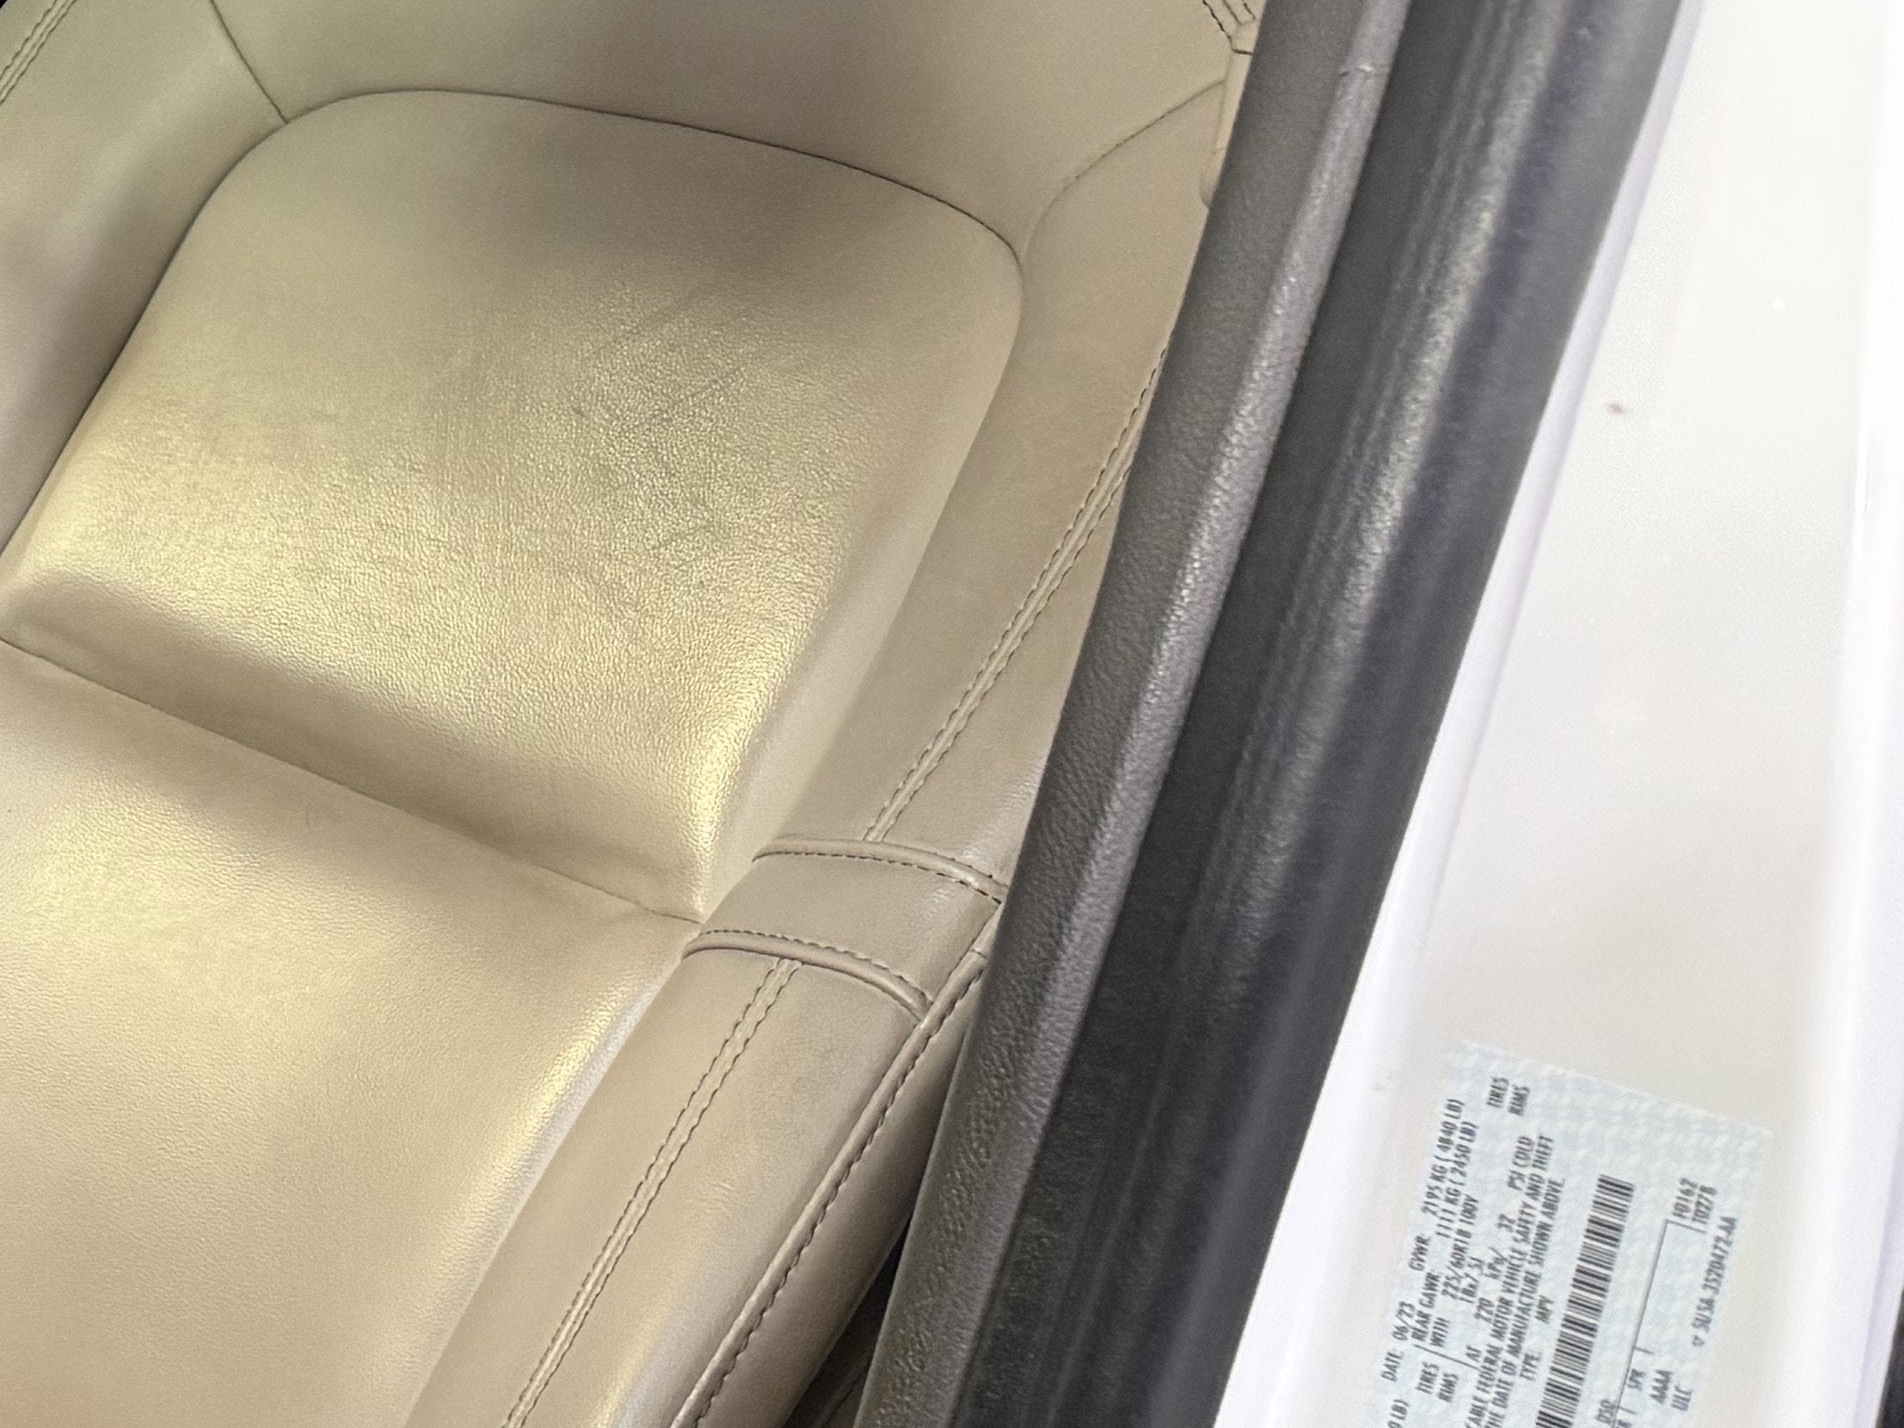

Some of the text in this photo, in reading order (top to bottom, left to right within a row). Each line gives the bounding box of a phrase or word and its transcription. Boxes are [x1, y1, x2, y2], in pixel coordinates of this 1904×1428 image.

[1531, 1134, 1554, 1171] THEFT
[1523, 1172, 1546, 1201] AND
[1511, 1200, 1539, 1246] SAFETY
[1526, 1220, 1553, 1267] SHOWN
[1410, 1309, 1431, 1341] REAR
[1442, 1186, 1462, 1206] KG
[1462, 1343, 1482, 1362] AT
[1472, 1296, 1495, 1323] 220
[1511, 1134, 1535, 1169] COLD
[1499, 1246, 1527, 1296] VEHICLE
[1428, 1315, 1450, 1348] WITH
[1439, 1227, 1474, 1300] 225/60R18
[1533, 1294, 1555, 1324] MPV
[1390, 1299, 1416, 1342] 06/23
[1488, 1295, 1514, 1341] MOTOR
[1503, 1270, 1541, 1358] MANUFACTURE
[1474, 1342, 1502, 1394] FEDERAL
[1499, 1359, 1518, 1377] OF
[1490, 1377, 1513, 1409] DATE
